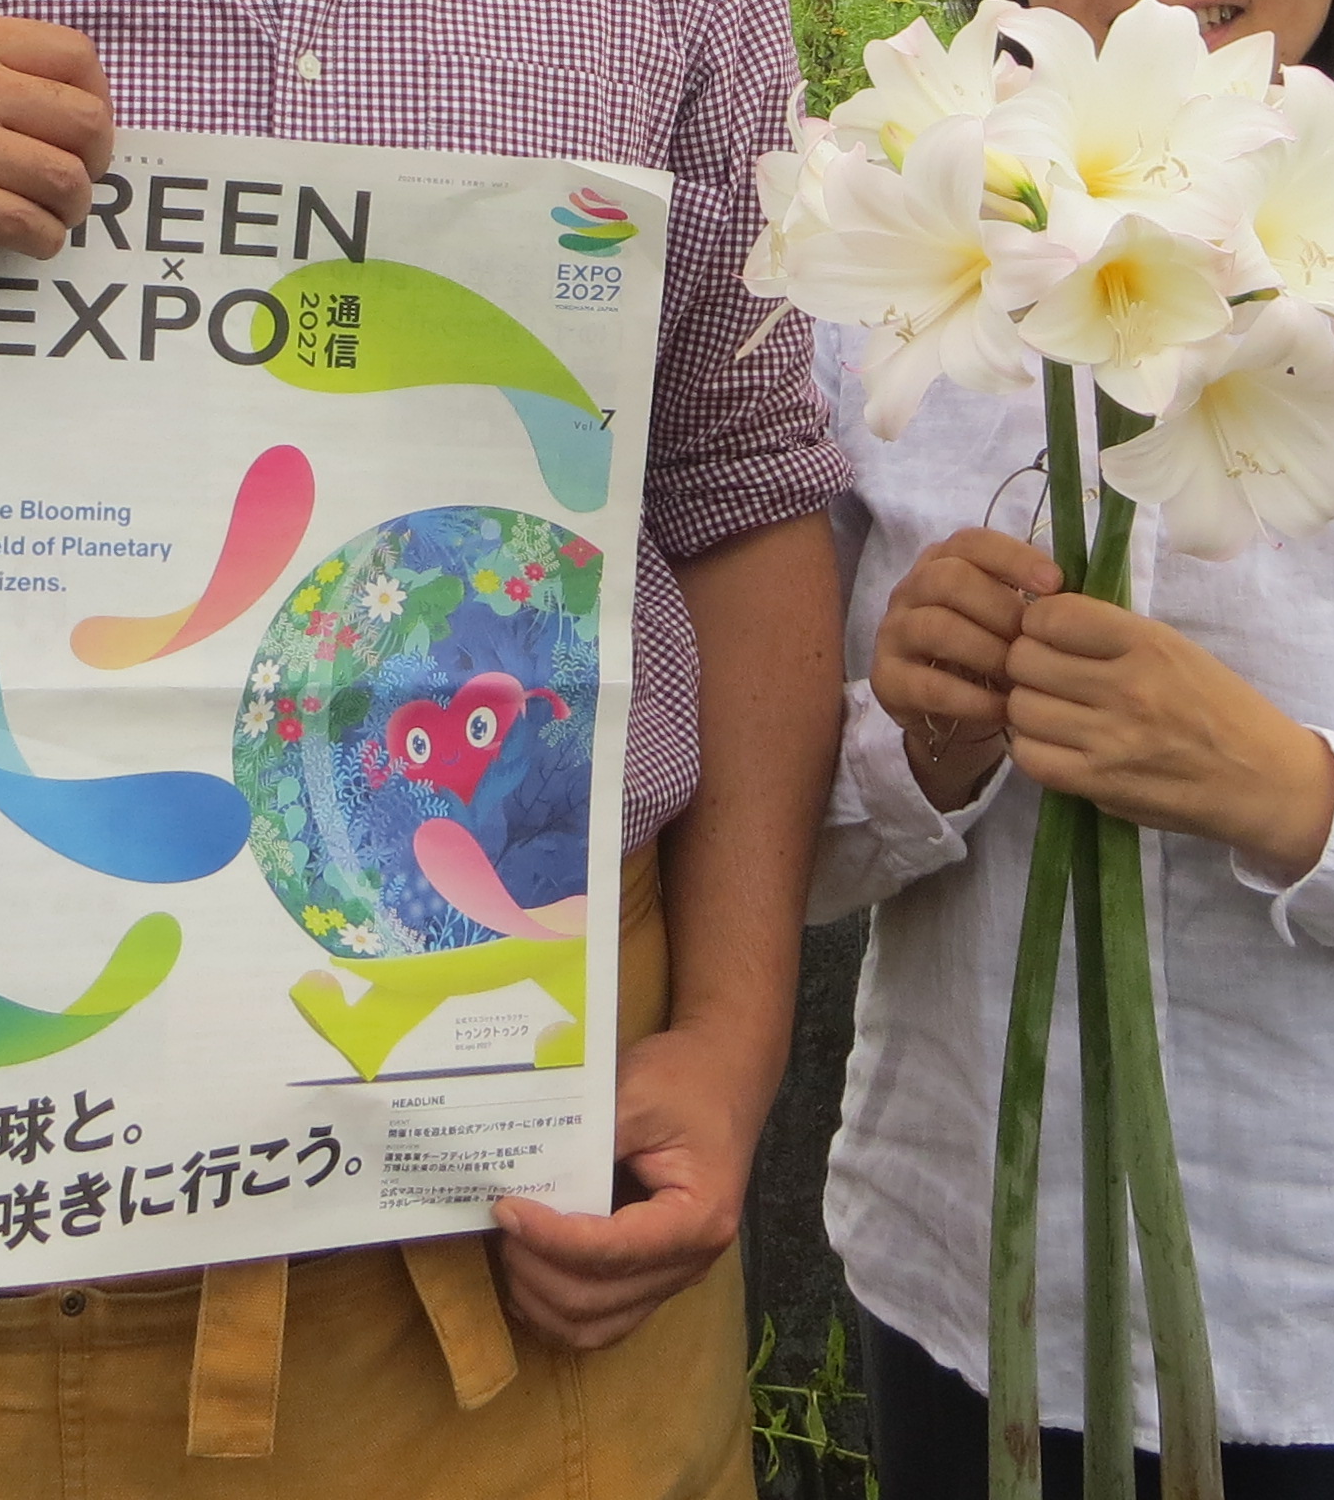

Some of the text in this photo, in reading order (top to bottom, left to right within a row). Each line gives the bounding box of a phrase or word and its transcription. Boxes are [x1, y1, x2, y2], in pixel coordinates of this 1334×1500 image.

[70, 171, 372, 263] REEN
[557, 264, 622, 283] EXPO
[555, 283, 621, 301] 2027
[297, 292, 320, 368] 2027
[323, 294, 361, 370] 通信
[599, 409, 616, 431] 7
[20, 500, 132, 527] Blooming
[31, 536, 56, 556] of
[61, 536, 172, 563] Planetary
[455, 1025, 529, 1040] トゥンクトゥンク
[391, 1095, 446, 1108] HEADLINE
